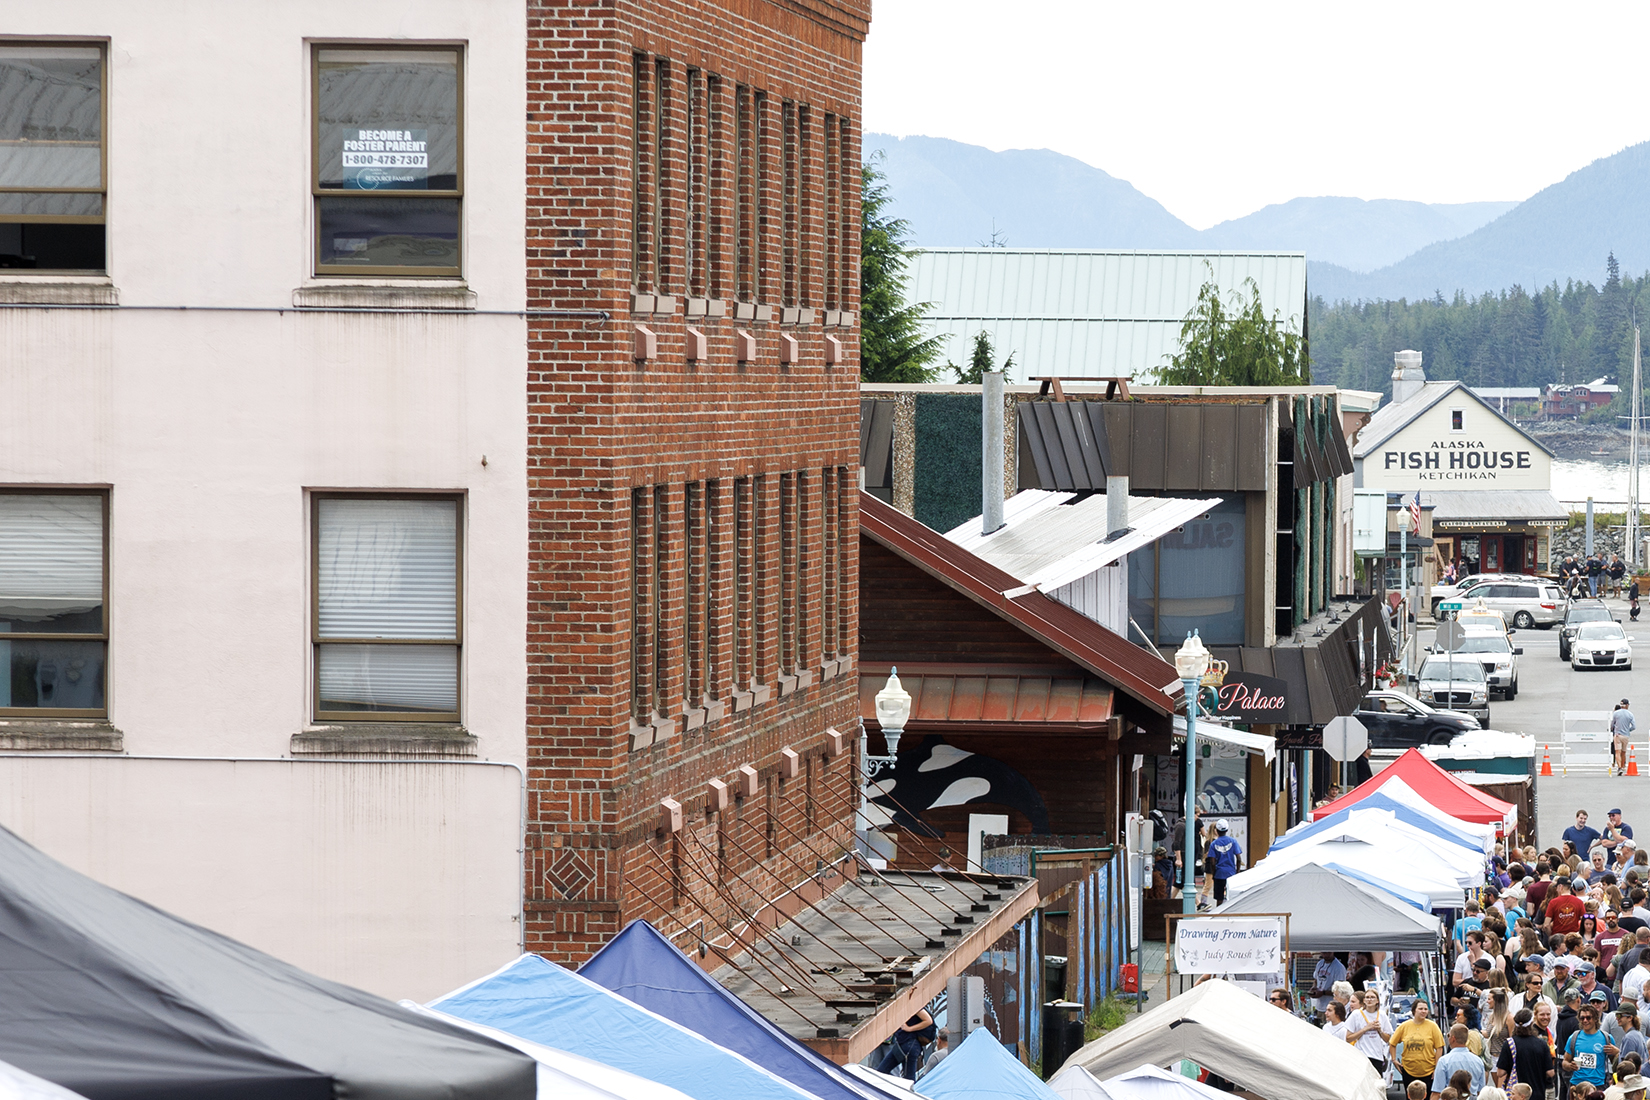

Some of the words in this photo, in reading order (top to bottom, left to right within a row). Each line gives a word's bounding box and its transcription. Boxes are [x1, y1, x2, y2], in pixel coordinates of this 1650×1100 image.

[359, 130, 403, 140] BECOME
[404, 130, 412, 140] A
[344, 140, 385, 151] FOSTER
[385, 141, 427, 151] PARENT
[345, 155, 425, 165] 1-800-478-7307
[1430, 440, 1485, 449] ALASKA
[1384, 451, 1440, 470] FISH
[1449, 451, 1532, 469] HOUSE
[1419, 472, 1497, 480] KETCHIKAN
[1217, 682, 1285, 711] Palace
[1180, 928, 1220, 942] Drawing
[1220, 928, 1247, 941] From
[1248, 928, 1278, 940] Nature
[1202, 948, 1224, 962] Judy
[1226, 948, 1253, 960] Roush
